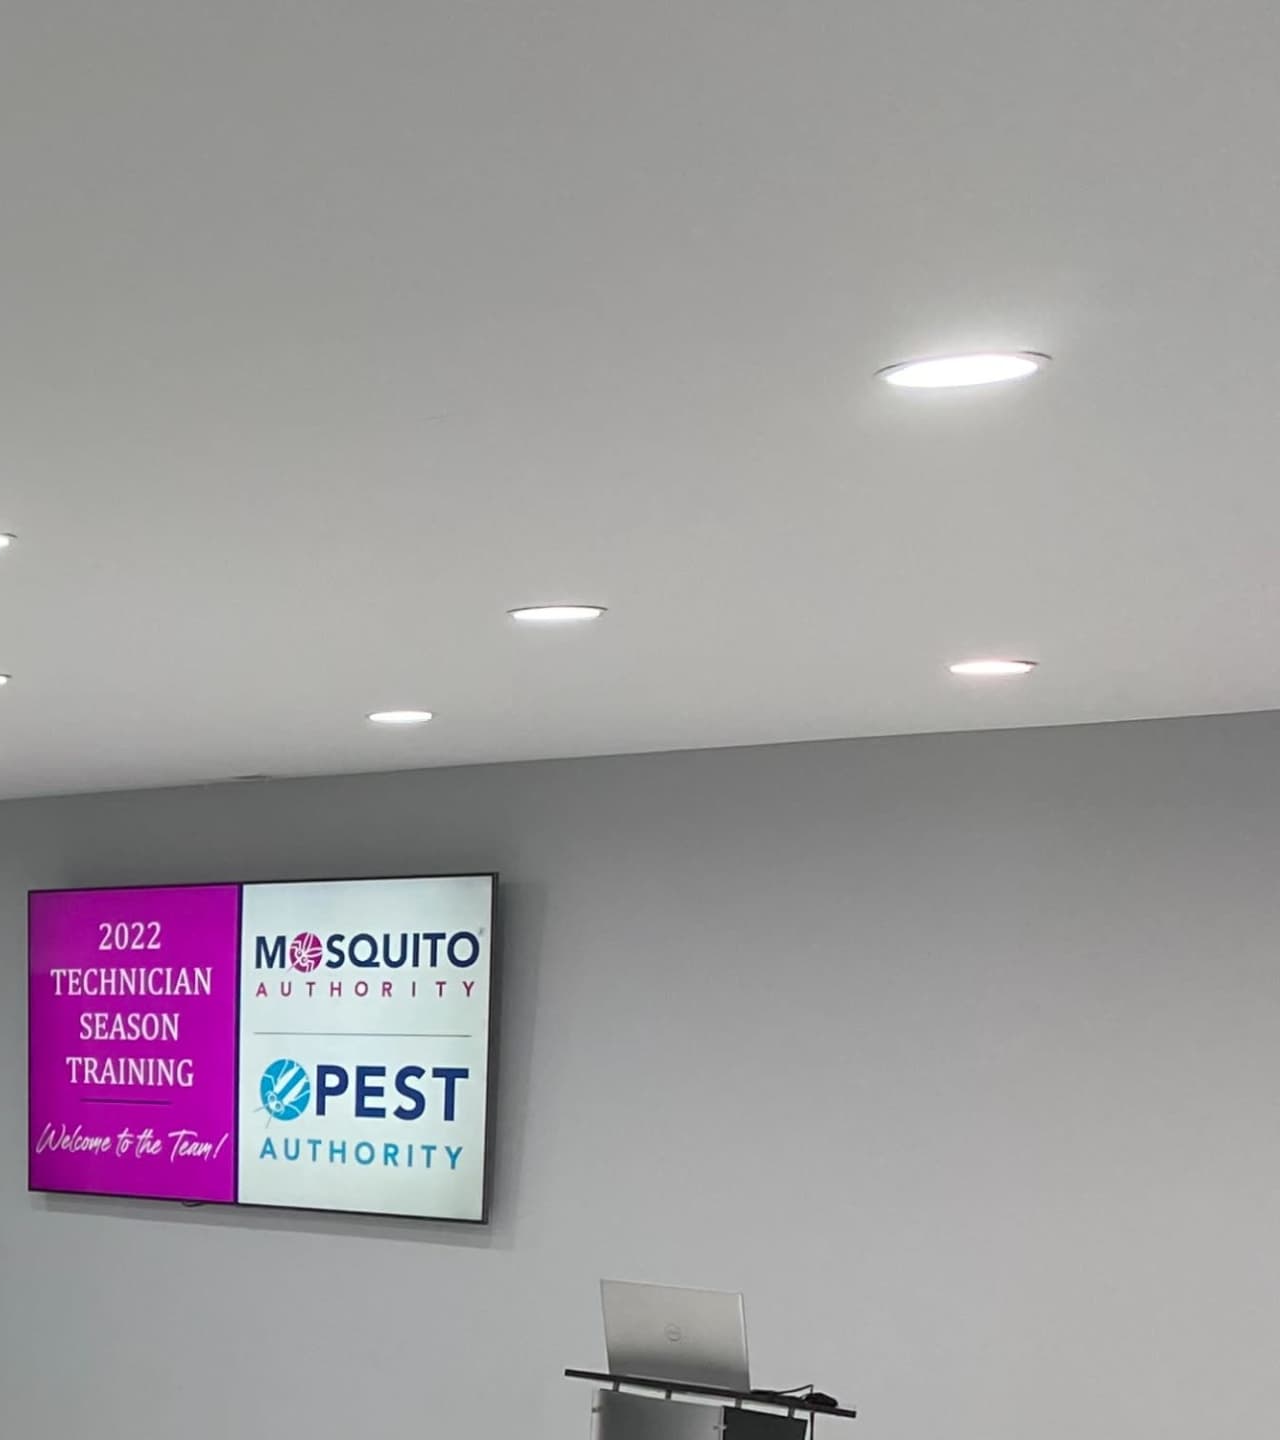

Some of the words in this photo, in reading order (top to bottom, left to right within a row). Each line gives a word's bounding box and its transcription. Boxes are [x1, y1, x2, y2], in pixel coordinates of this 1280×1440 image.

[98, 921, 162, 951] 2022
[255, 930, 481, 974] MOSQUITO
[50, 966, 213, 997] TECHNICIAN
[255, 980, 476, 998] AUTHORITY
[79, 1012, 180, 1041] SEASON
[66, 1056, 194, 1088] TRAINING
[316, 1065, 470, 1122] PEST
[35, 1122, 112, 1154] Welcome
[116, 1127, 135, 1158] to
[135, 1128, 162, 1158] the
[167, 1129, 230, 1163] Team!
[259, 1136, 464, 1171] AUTHORITY
